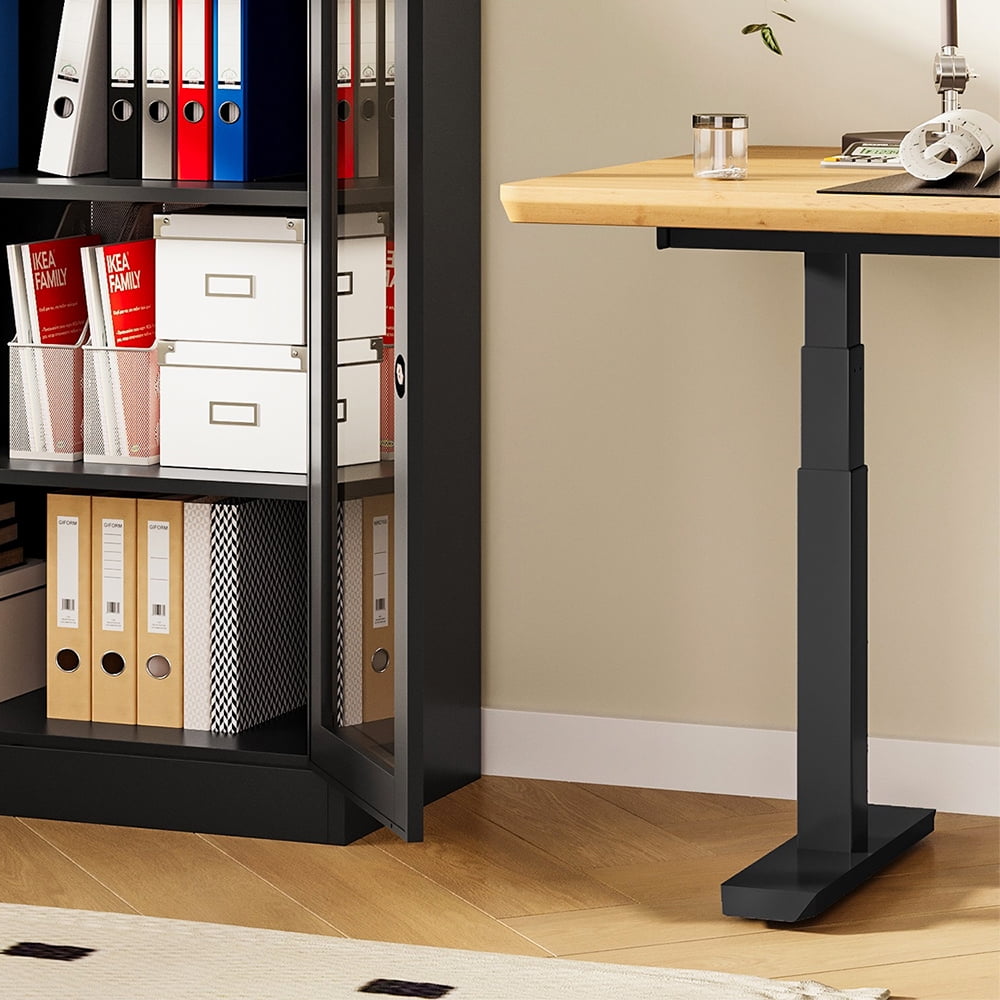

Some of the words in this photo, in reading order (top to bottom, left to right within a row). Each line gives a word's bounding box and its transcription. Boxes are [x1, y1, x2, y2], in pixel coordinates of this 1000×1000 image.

[32, 250, 56, 270] IKEA
[106, 252, 130, 273] IKEA
[34, 267, 68, 291] FAMILY
[108, 270, 141, 293] FAMILY
